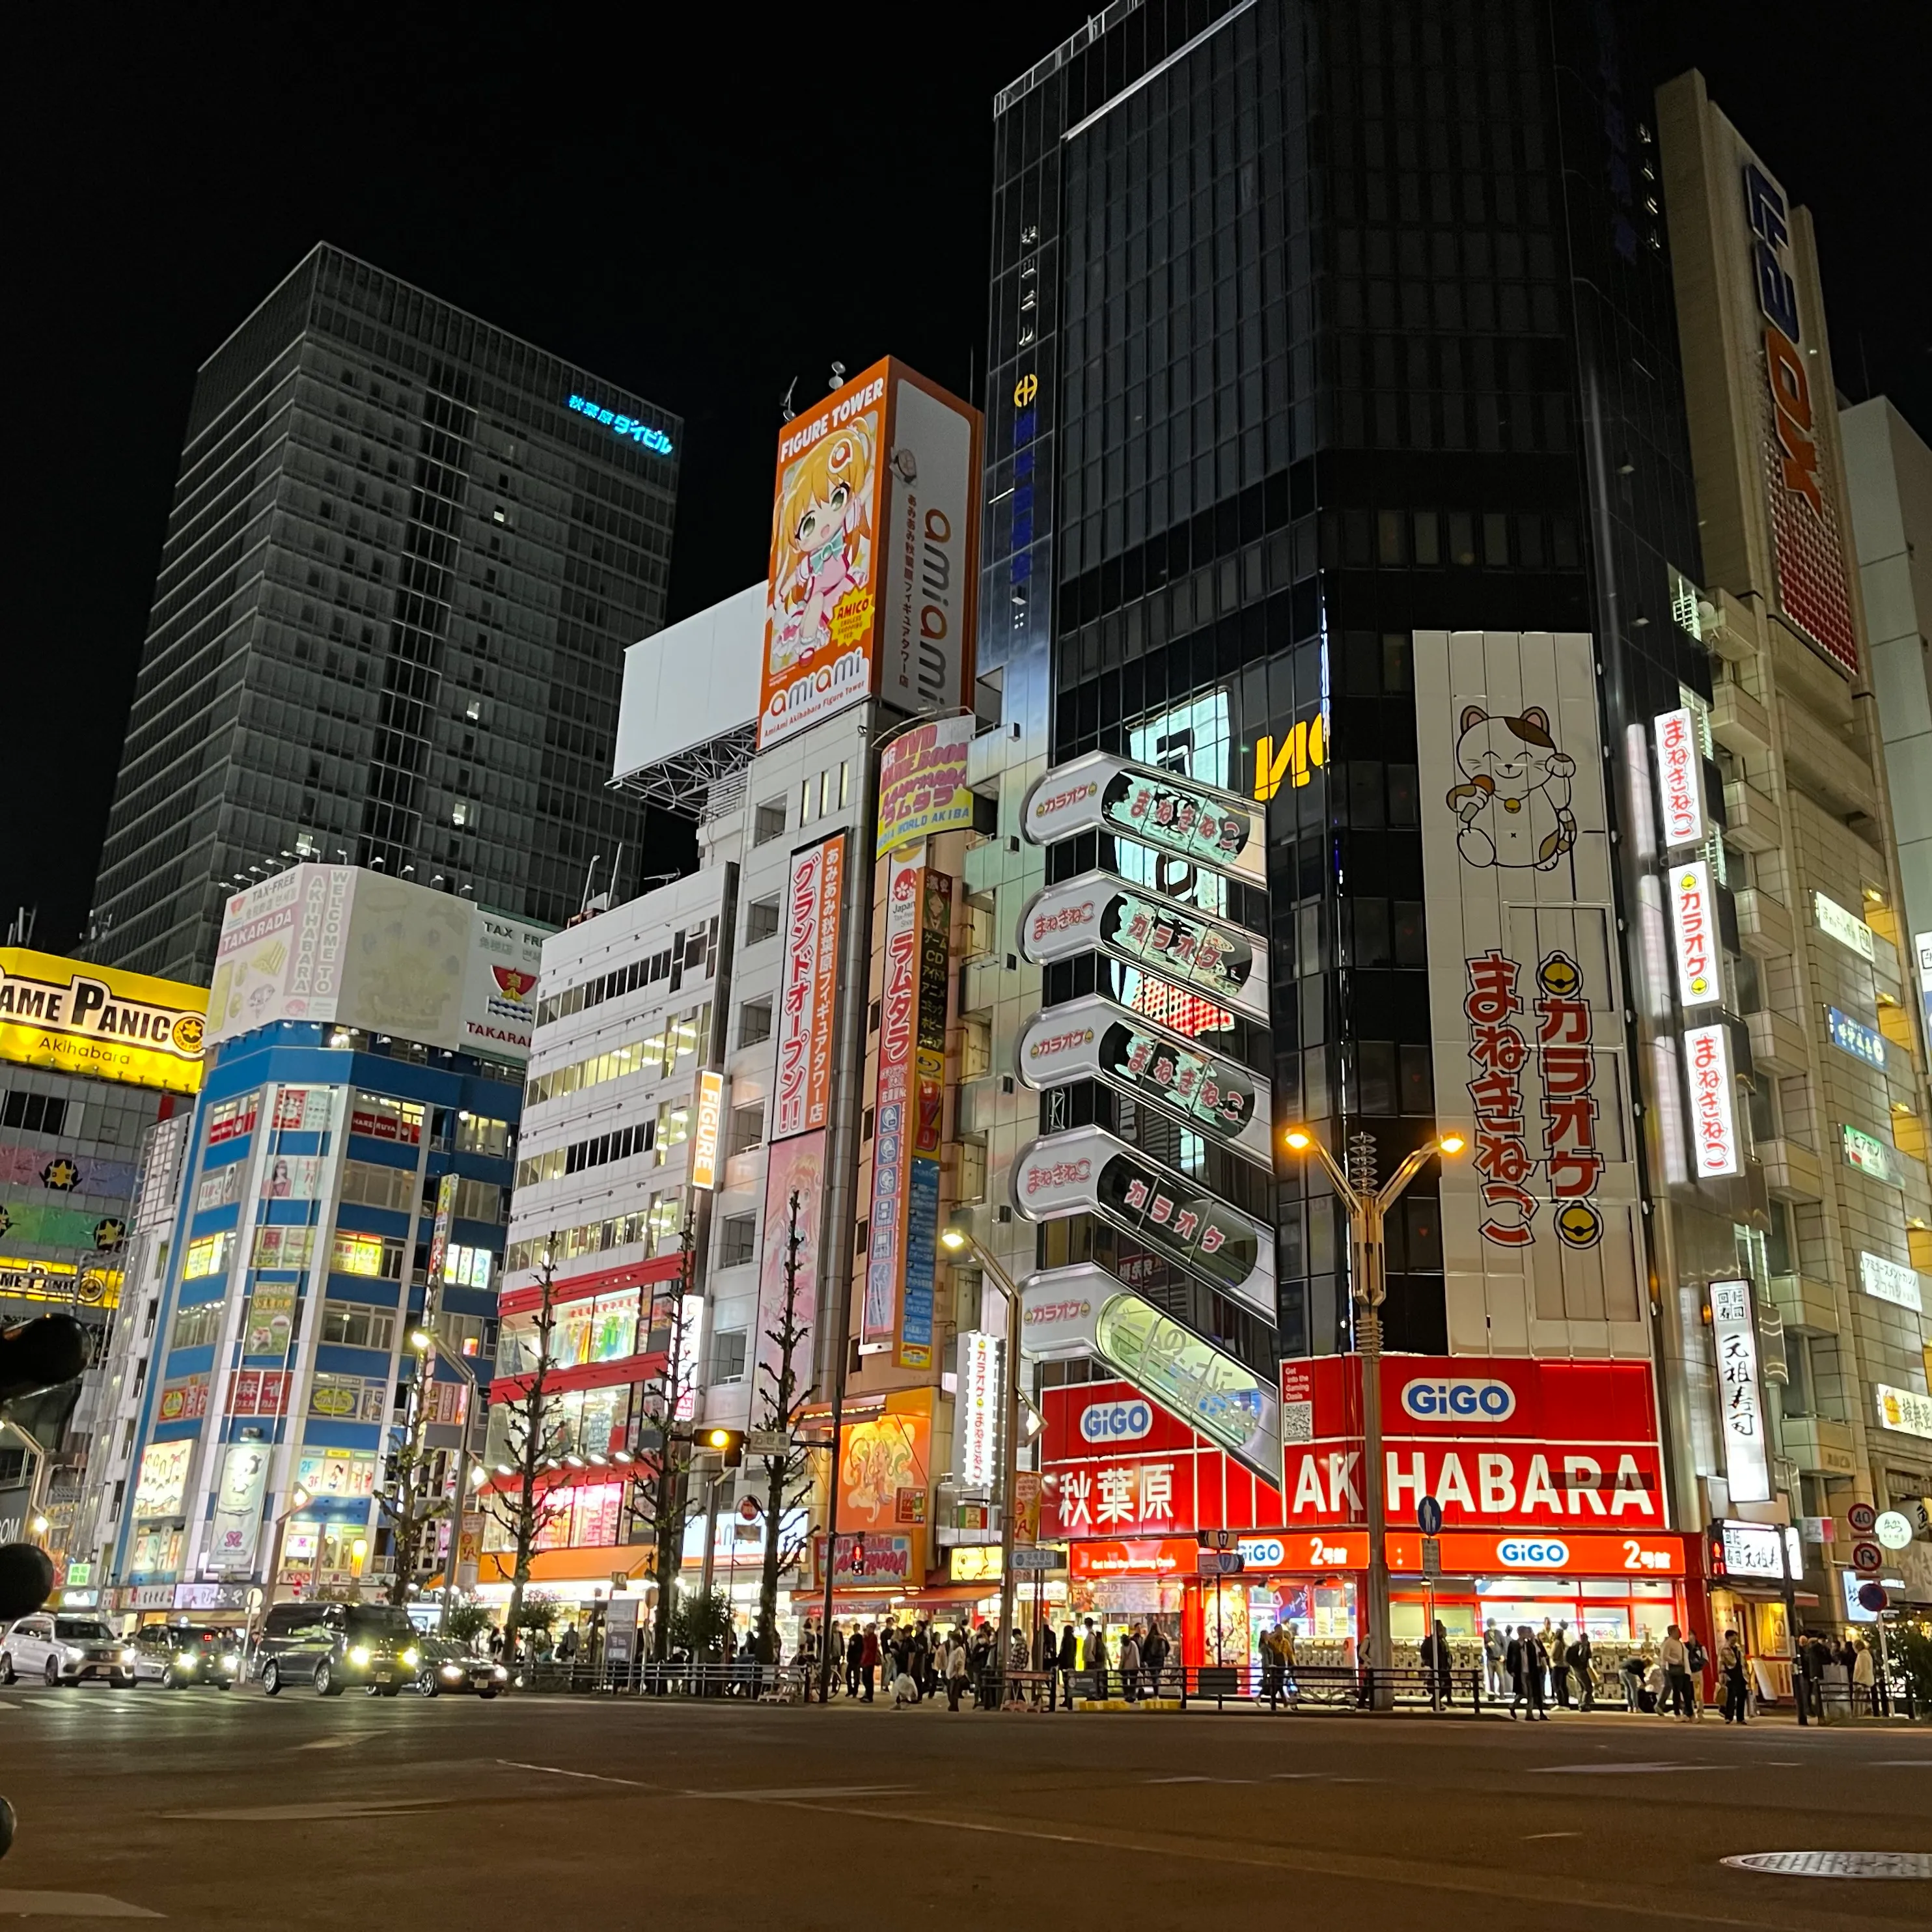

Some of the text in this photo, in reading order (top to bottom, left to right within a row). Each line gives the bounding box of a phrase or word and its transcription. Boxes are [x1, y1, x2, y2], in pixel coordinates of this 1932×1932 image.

[569, 394, 672, 454] 秋葉原ダイビル
[781, 378, 884, 463] FIGURE TOWER
[837, 598, 869, 620] AMICO
[918, 508, 951, 704] amiami
[771, 650, 861, 717] amiami
[790, 702, 821, 724] Akihabara
[823, 692, 844, 708] Figure
[845, 681, 864, 693] Tower
[1662, 716, 1694, 838] まねきねこ
[1044, 785, 1088, 813] カラオケ
[898, 813, 927, 835] WORLD
[931, 807, 969, 824] AKIBA
[1130, 790, 1241, 849] まねきねこ
[252, 872, 296, 900] TAX-FREE
[223, 909, 292, 951] TAKARADA
[293, 876, 324, 992] AKIHABARA
[322, 870, 349, 960] WELCOME
[484, 921, 513, 939] TAX
[1032, 900, 1096, 942] まねきねこ
[924, 932, 947, 950] ゲーム
[1129, 915, 1222, 969] カラオケ
[1679, 892, 1706, 978] カラオケ
[926, 949, 944, 965] CD
[316, 967, 332, 993] TO
[808, 848, 840, 1123] あみあみ秋葉原フィギュアタワー店
[882, 930, 915, 1062] ラムタラ
[921, 981, 945, 998] アニメ
[71, 982, 171, 1042] PANIC
[921, 999, 943, 1016] コミック
[921, 1016, 943, 1031] ホビー
[39, 1037, 130, 1065] Akihabara
[1038, 1030, 1086, 1052] カラオケ
[1127, 1044, 1245, 1120] まねきねこ
[1463, 950, 1539, 1247] まねきねこ
[1534, 999, 1604, 1203] カラオケ
[1694, 1033, 1730, 1170] まねきねこ
[352, 1118, 397, 1133] HARERUYA
[695, 1089, 720, 1171] FIGURE
[1026, 1157, 1091, 1194] まねきねこ
[1124, 1180, 1226, 1254] カラオケ
[1032, 1299, 1081, 1323] カラオケ
[975, 1351, 986, 1398] カラオケ
[1286, 1383, 1310, 1392] Gaming
[1287, 1375, 1299, 1383] into
[1722, 1334, 1754, 1436] 元祖寿司
[1286, 1392, 1303, 1400] Oasis
[1407, 1383, 1510, 1416] GiGO
[1084, 1405, 1149, 1437] GiGO
[972, 1411, 985, 1480] まねきねこ
[301, 1460, 313, 1473] 2F
[308, 1476, 320, 1488] 3F
[1293, 1450, 1655, 1516] AKHABARA
[1058, 1463, 1174, 1528] 秋葉原
[1855, 1511, 1871, 1524] 40
[1310, 1538, 1347, 1565] 2号館
[1502, 1543, 1564, 1564] GiGO
[1623, 1540, 1672, 1569] 2号館
